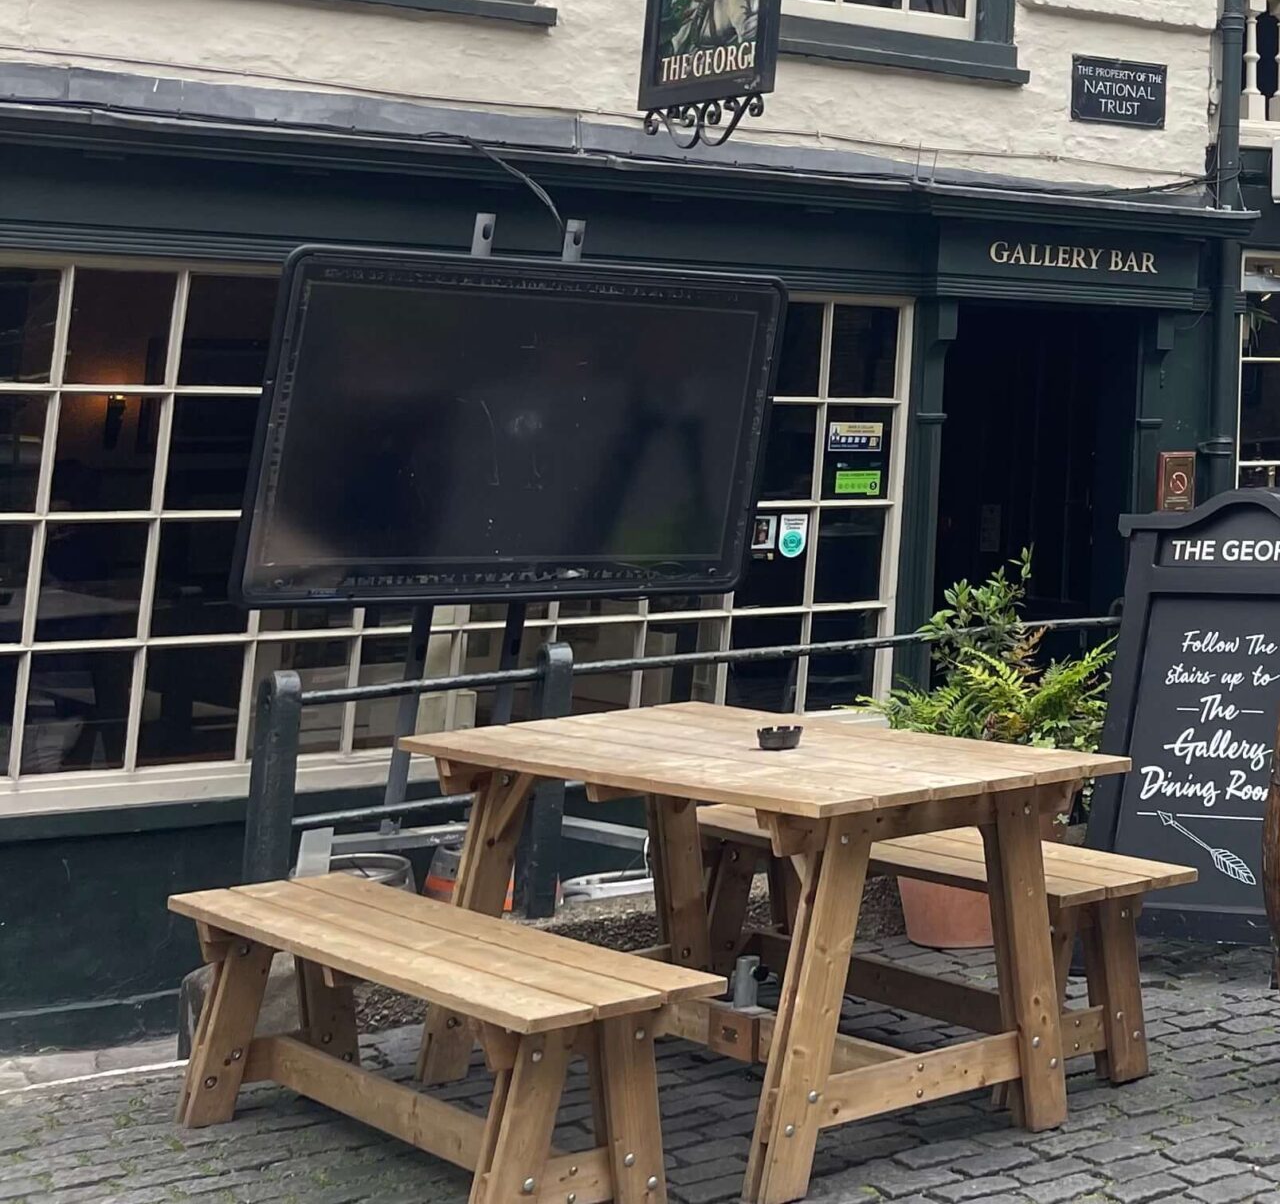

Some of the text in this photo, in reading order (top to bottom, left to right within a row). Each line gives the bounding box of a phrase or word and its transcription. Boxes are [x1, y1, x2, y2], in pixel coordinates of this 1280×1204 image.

[661, 54, 690, 82] THE
[1077, 65, 1163, 84] THE PROPERTY OF THE
[1084, 79, 1156, 100] NATIONAL
[1099, 98, 1141, 115] TRUST
[989, 241, 1158, 273] GALLERY BAR
[1172, 540, 1216, 560] THE
[1182, 630, 1278, 655] Follow The
[1165, 662, 1280, 691] stairs up to
[1200, 693, 1239, 723] The
[1163, 727, 1274, 771] Gallery
[1139, 765, 1221, 807] Dining
